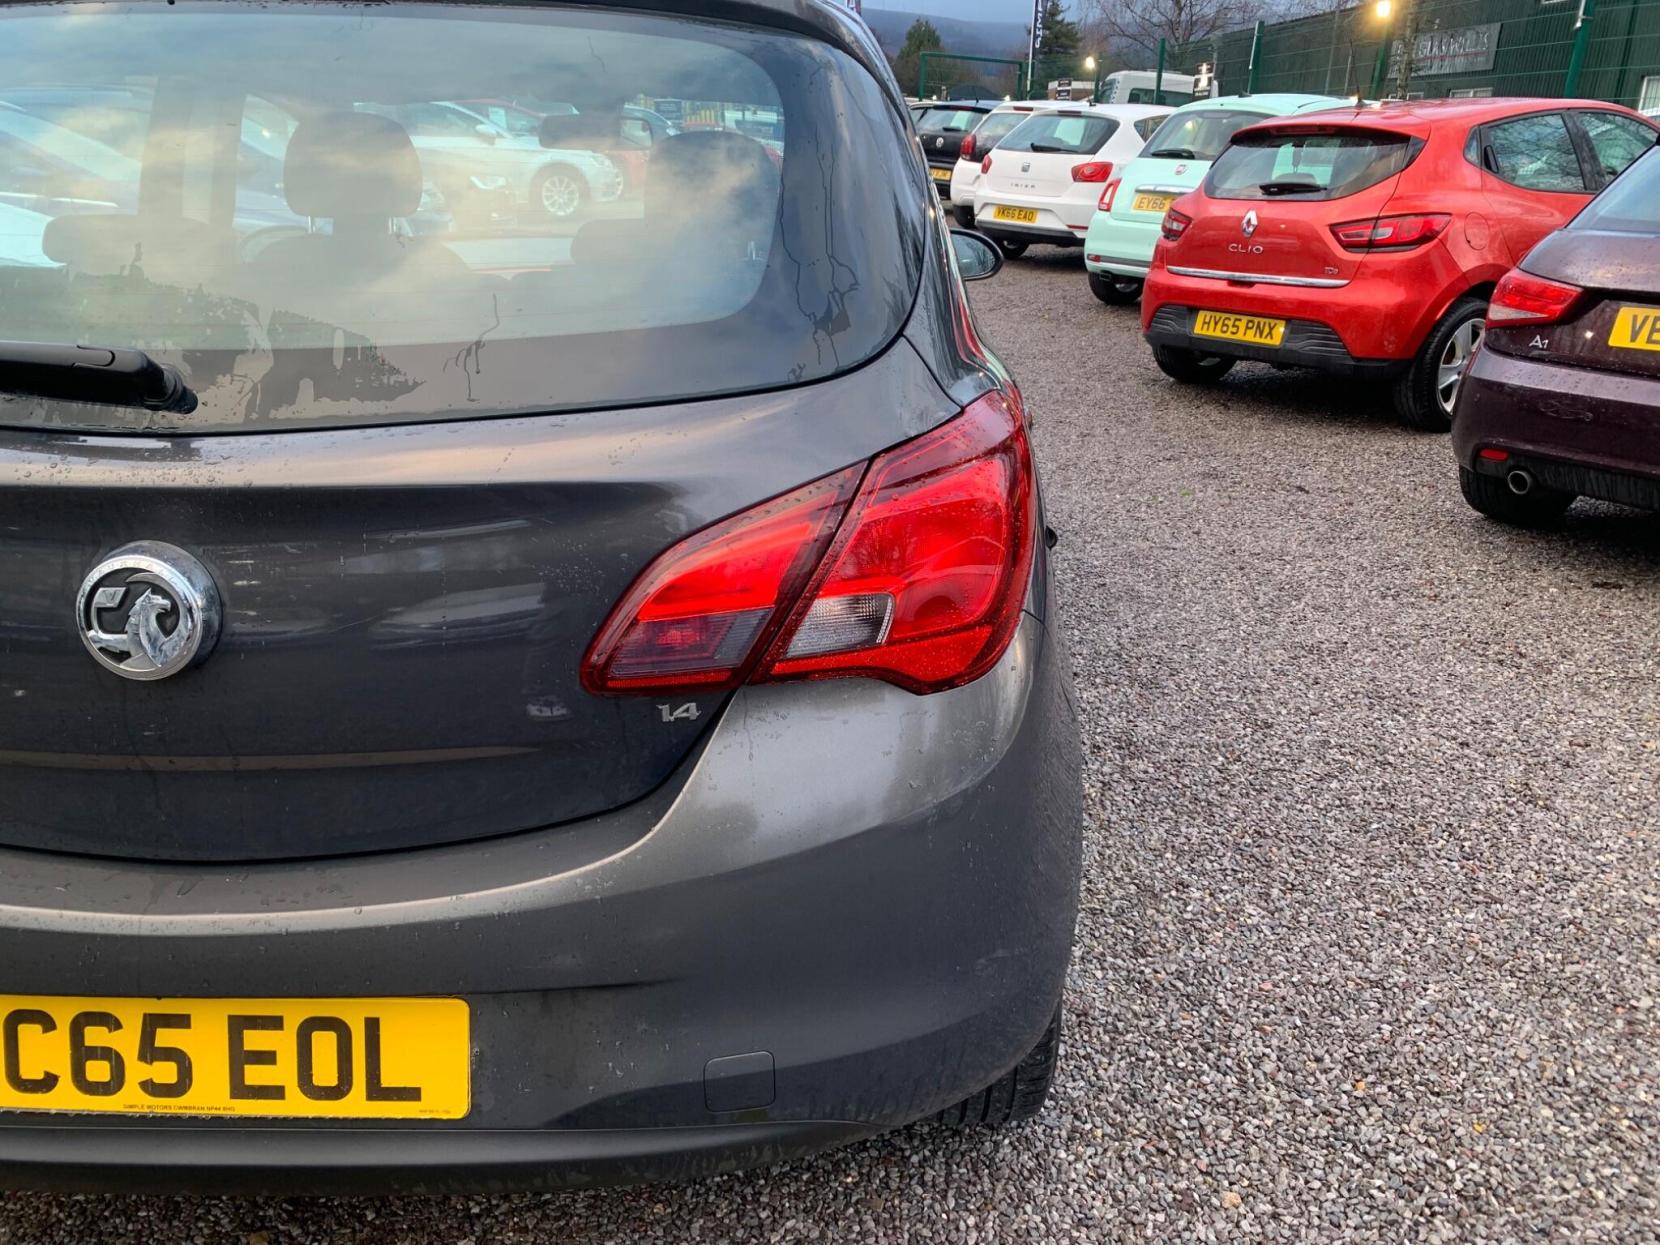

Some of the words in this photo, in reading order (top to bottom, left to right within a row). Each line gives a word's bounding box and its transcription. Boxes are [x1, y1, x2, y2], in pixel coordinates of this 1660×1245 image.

[1228, 243, 1264, 254] CLIO
[1200, 313, 1243, 335] HY65
[1243, 319, 1278, 340] PNX
[1529, 334, 1549, 349] A1
[3, 1008, 194, 1099] C65
[227, 1014, 422, 1103] EOL
